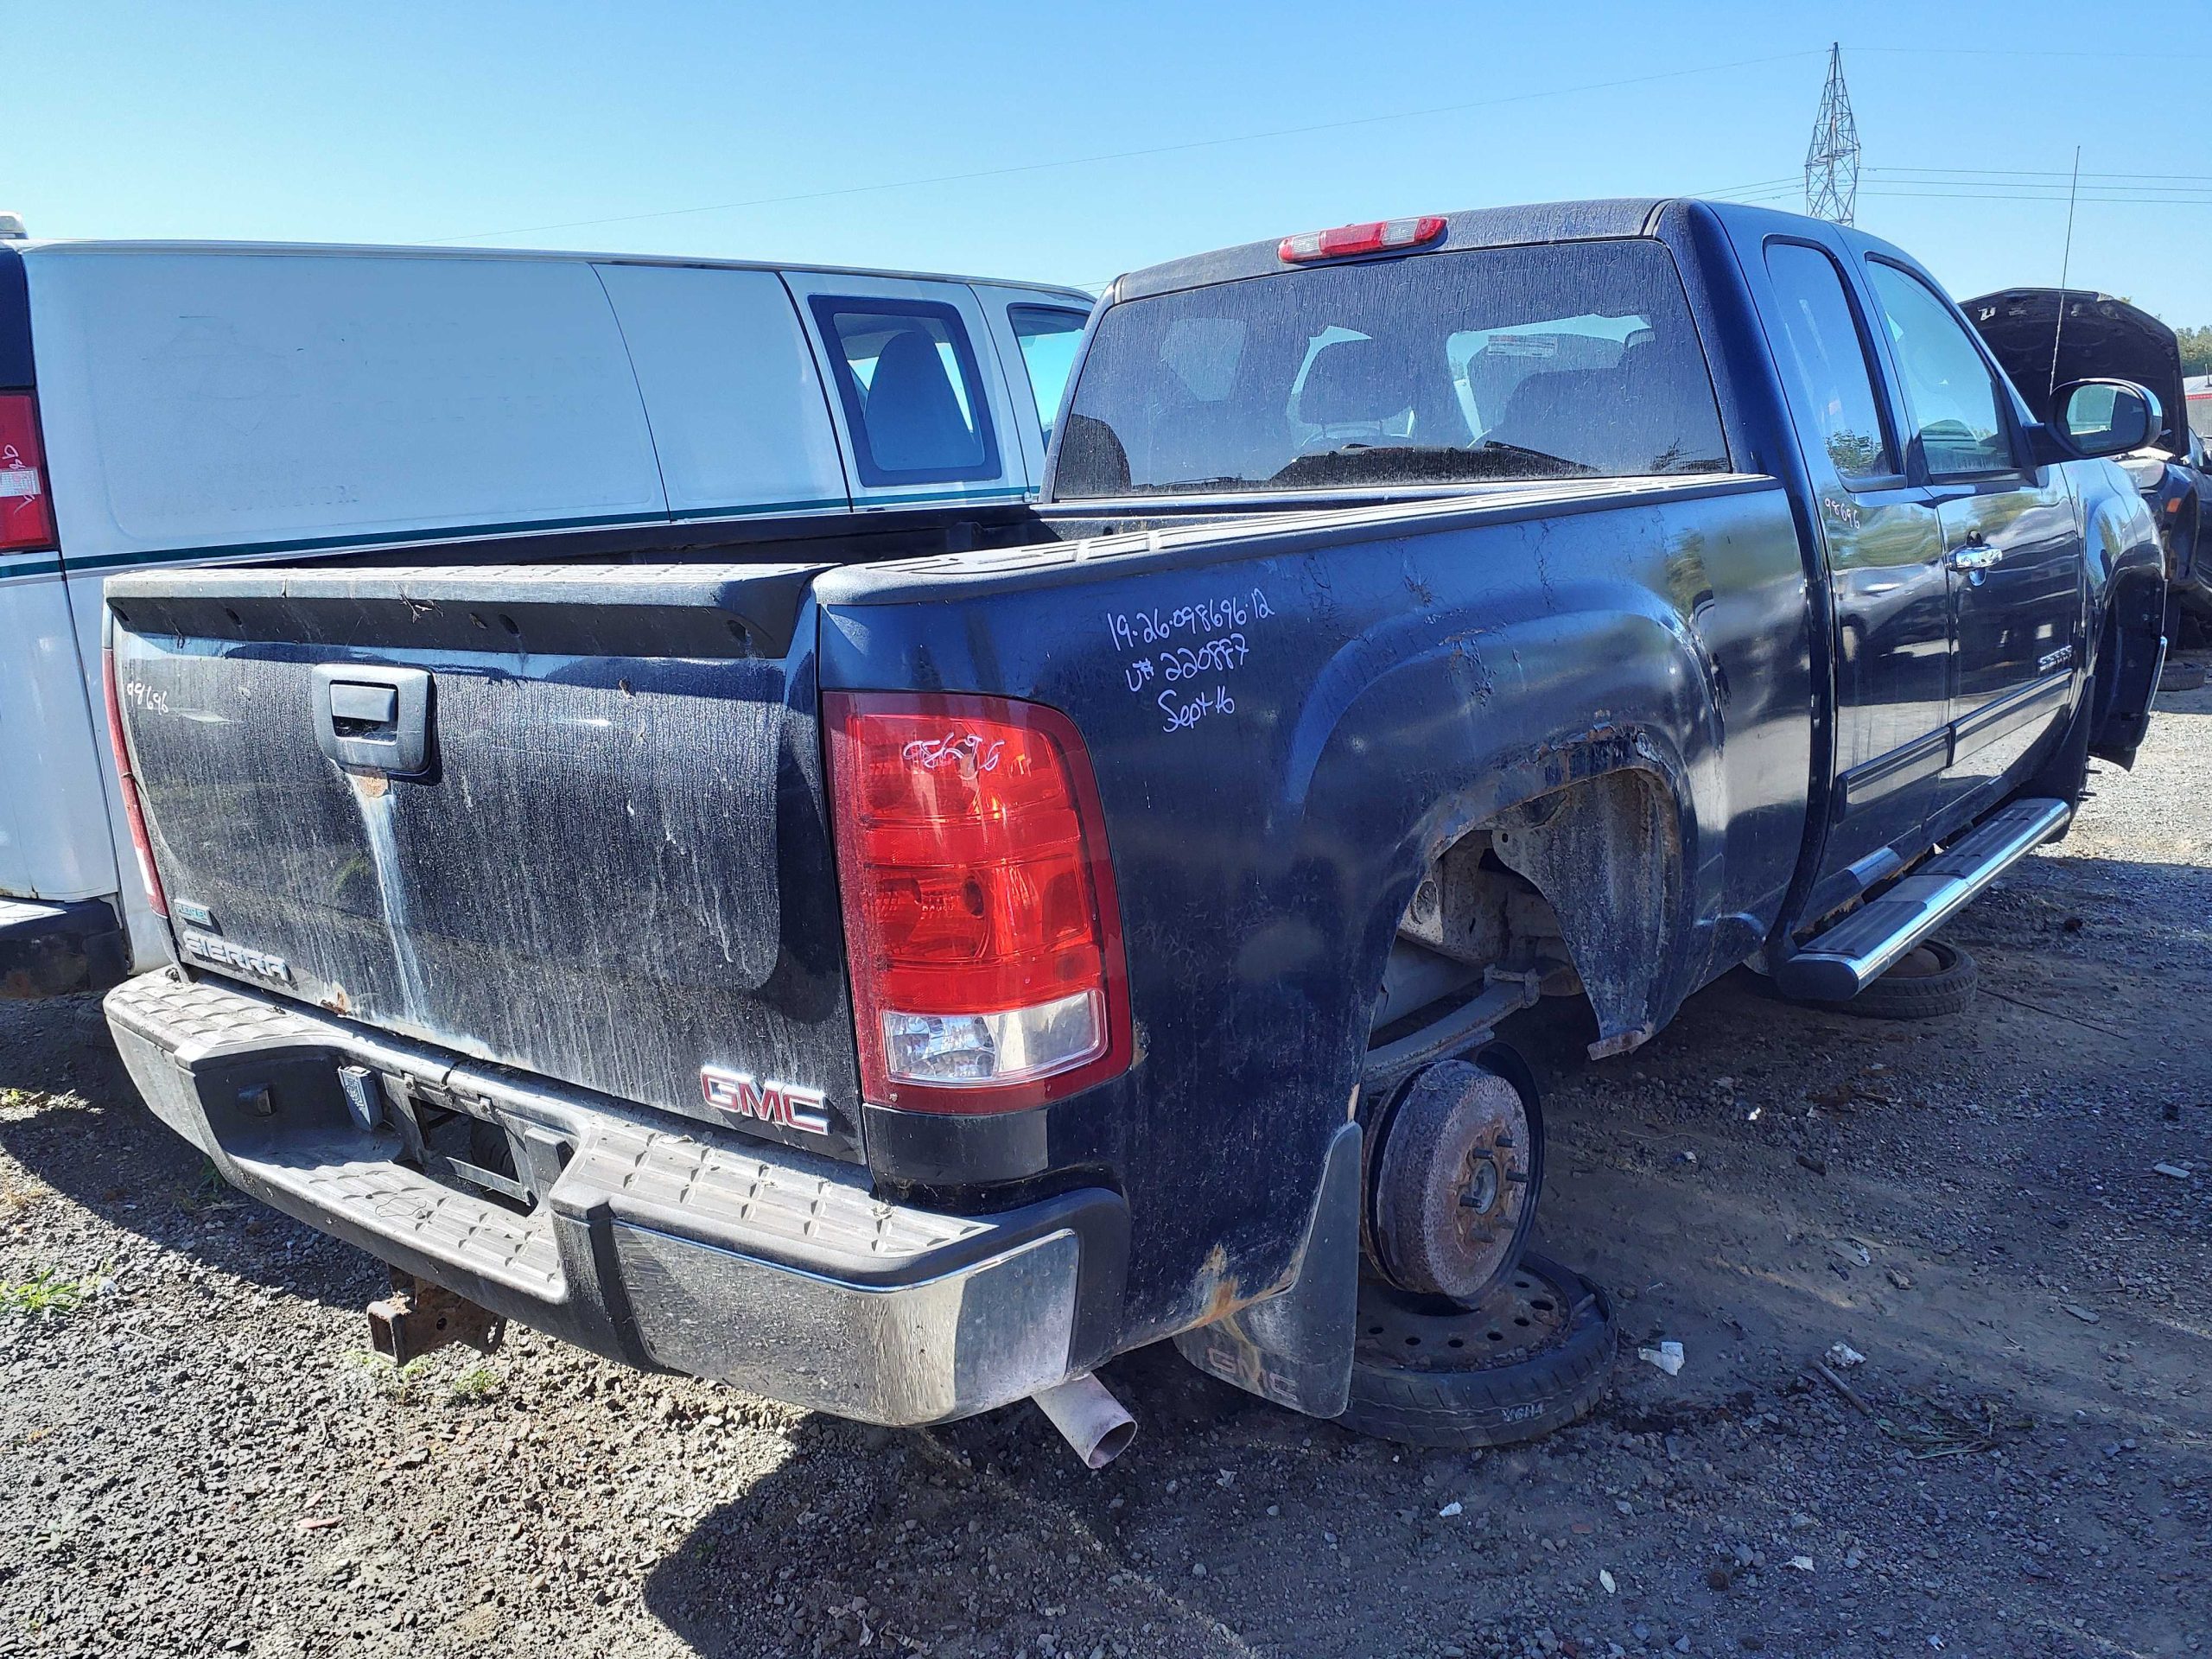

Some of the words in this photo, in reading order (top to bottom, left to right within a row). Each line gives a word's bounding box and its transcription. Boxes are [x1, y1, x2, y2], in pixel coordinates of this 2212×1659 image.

[1824, 498, 1860, 530] 98696
[1160, 632, 1249, 681] 220887
[126, 680, 169, 716] 98696
[183, 930, 289, 982] SIERRA
[701, 1065, 830, 1136] GMC
